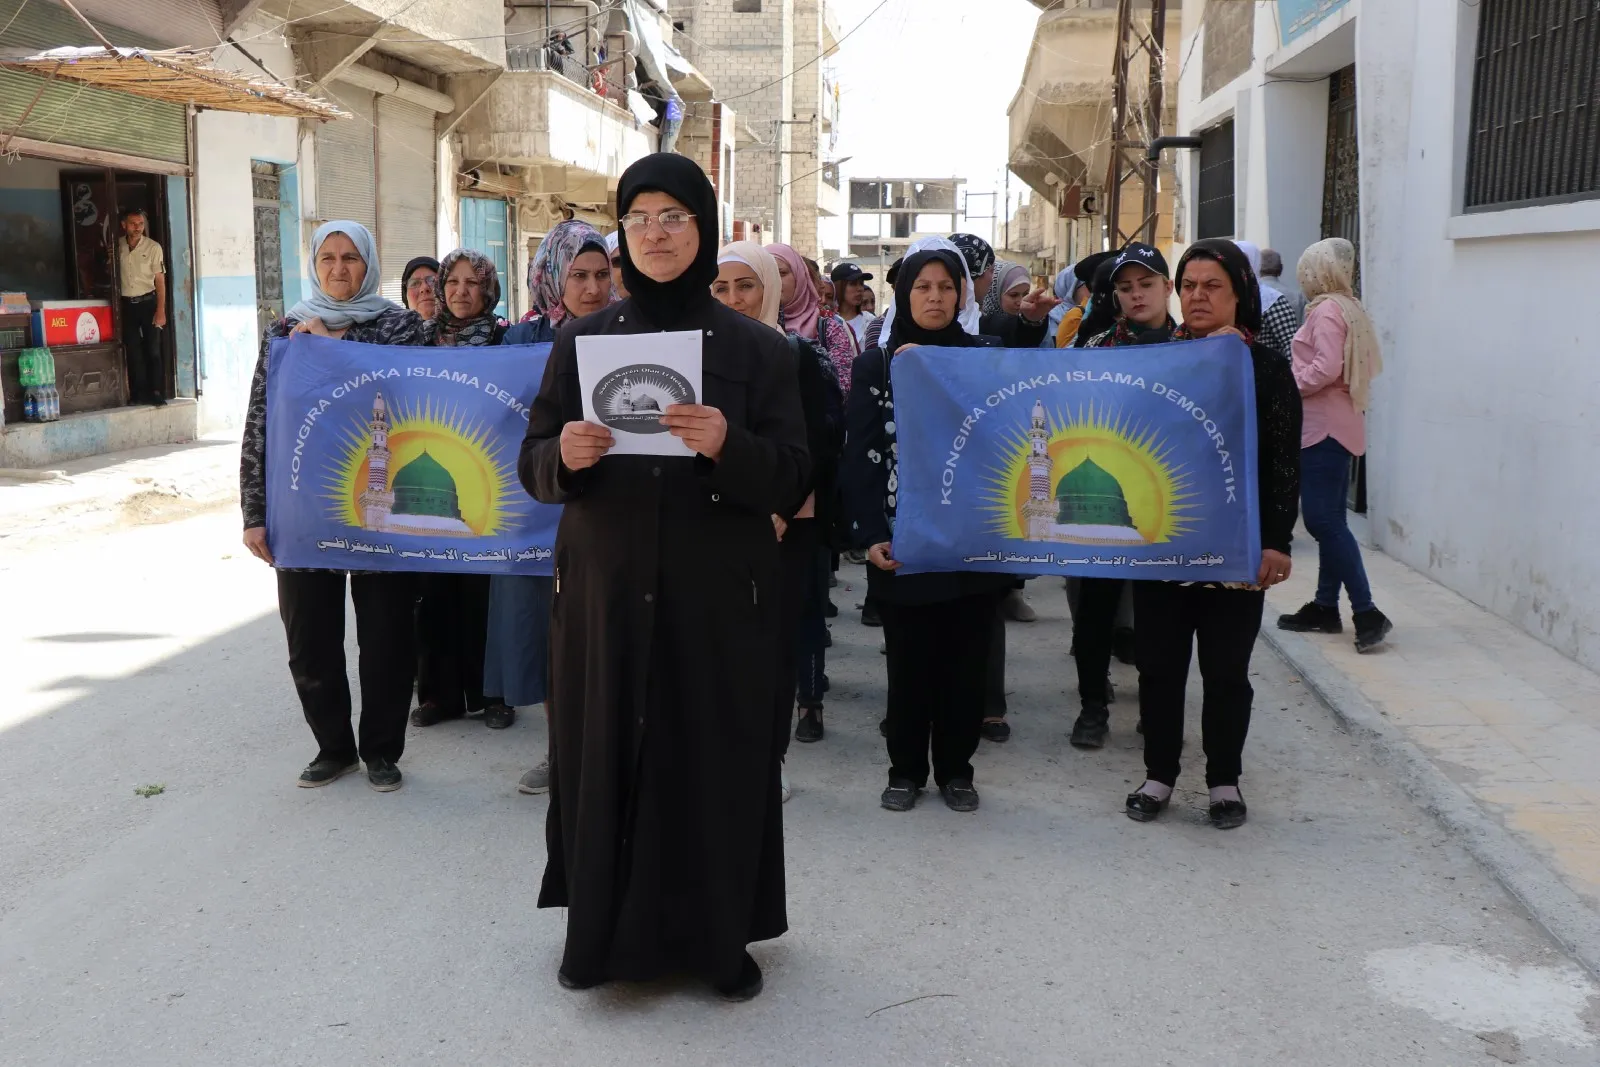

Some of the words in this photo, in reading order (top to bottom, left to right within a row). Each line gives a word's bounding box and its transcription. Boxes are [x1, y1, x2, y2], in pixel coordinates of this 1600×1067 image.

[52, 318, 68, 327] AKEL
[291, 399, 331, 490] KONGIRA
[332, 368, 400, 398] CIVAKA
[406, 367, 479, 388] ISLAMA
[484, 382, 531, 421] DEMO
[941, 407, 986, 505] KONGIRA
[986, 373, 1060, 407] CIVAKA
[1066, 370, 1146, 389] ISLAMA
[1152, 382, 1236, 504] DEMOQRATIK
[462, 543, 512, 562] المجتمع
[515, 541, 552, 562] مؤتمر
[1129, 554, 1184, 567] المجتمع
[1185, 553, 1225, 567] مؤتمر
